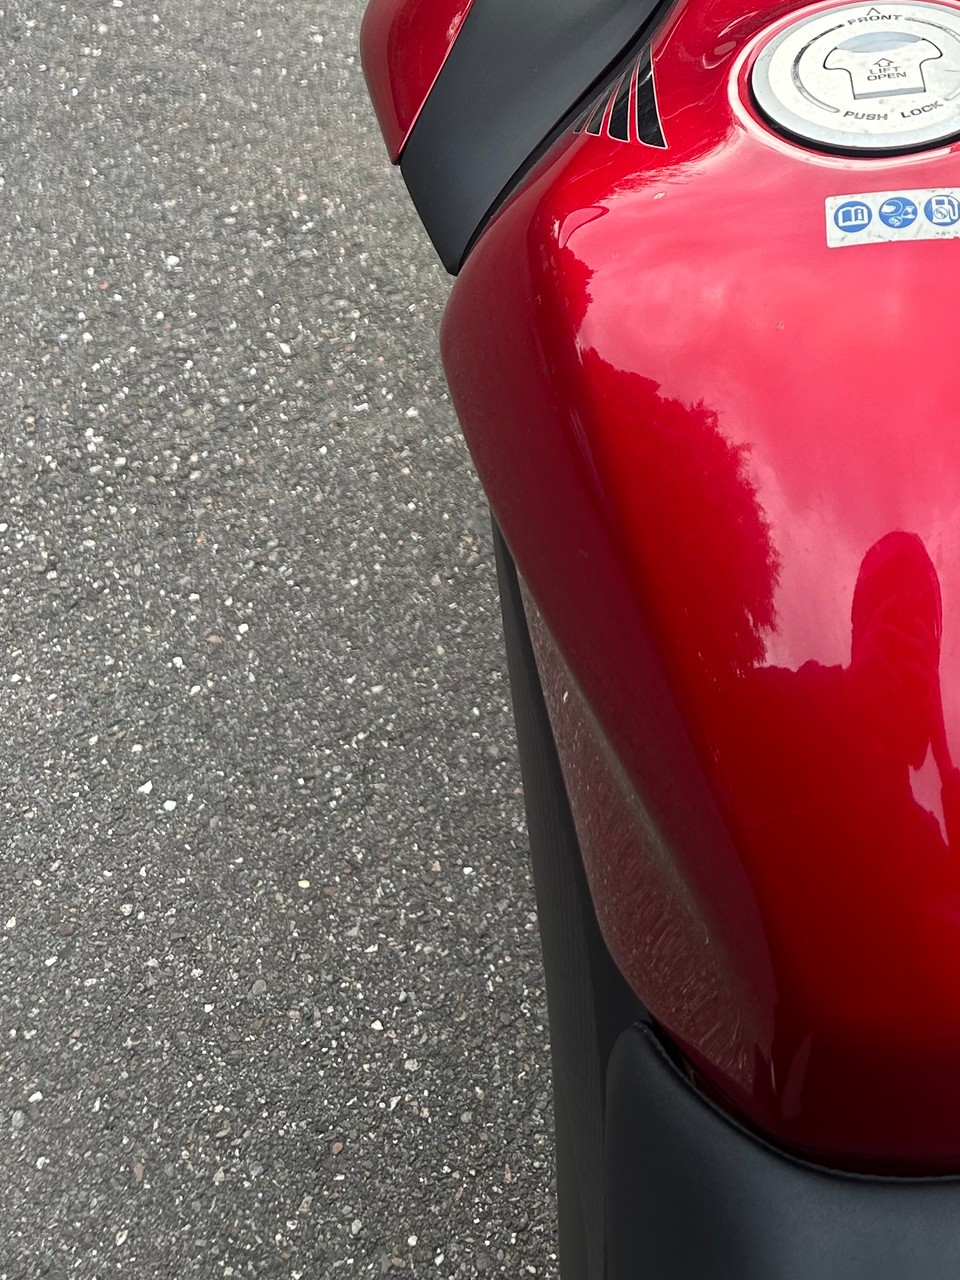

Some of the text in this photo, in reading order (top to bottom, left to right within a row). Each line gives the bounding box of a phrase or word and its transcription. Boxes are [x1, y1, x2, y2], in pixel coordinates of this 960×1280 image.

[848, 14, 902, 25] FRONT
[869, 66, 900, 74] LIFT
[867, 71, 907, 81] OPEN
[843, 100, 944, 121] PUSH LOCK
